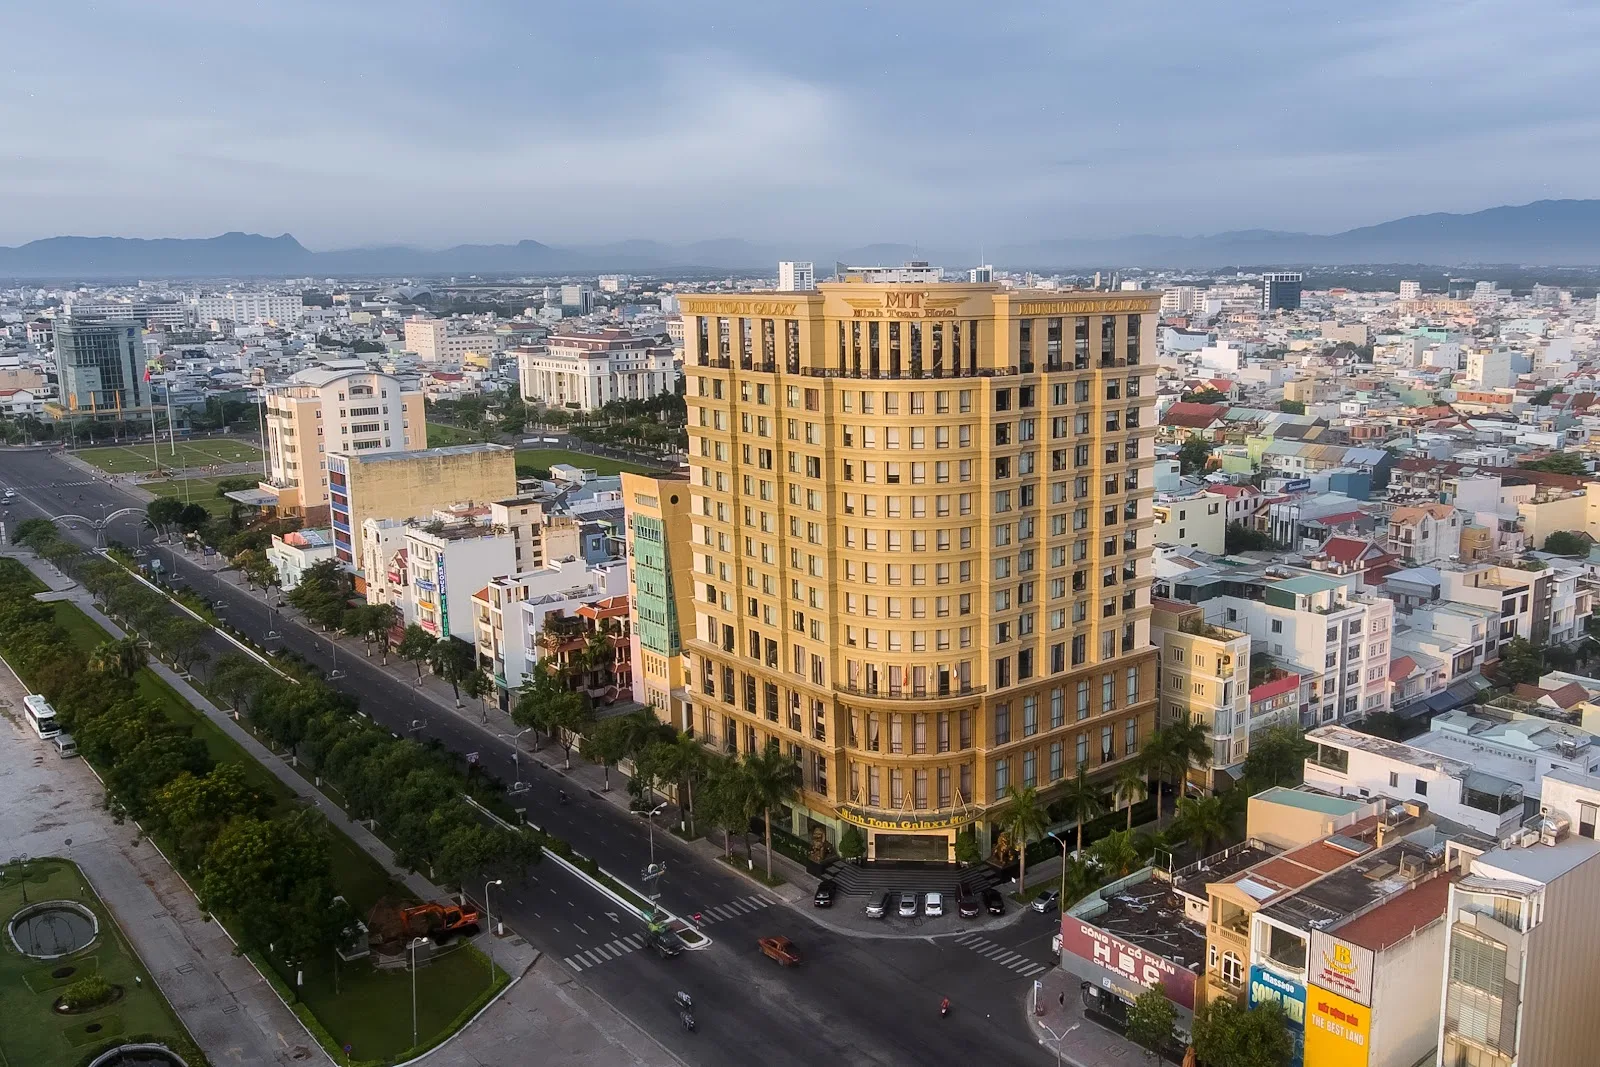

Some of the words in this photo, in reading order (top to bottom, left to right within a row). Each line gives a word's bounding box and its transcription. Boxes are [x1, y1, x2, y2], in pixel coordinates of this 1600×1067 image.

[853, 308, 883, 318] Minh
[887, 308, 920, 318] Toan
[924, 307, 957, 318] Hotel
[841, 807, 865, 824] Minh
[867, 817, 897, 829] Toan
[901, 819, 948, 829] Galaxy
[1080, 925, 1109, 945] CÔNG
[1111, 939, 1126, 951] TY
[1334, 942, 1352, 965] B
[1262, 971, 1295, 993] Massage
[1311, 1013, 1325, 1029] THE
[1326, 1020, 1345, 1037] BEST
[1345, 1027, 1364, 1046] LAND
